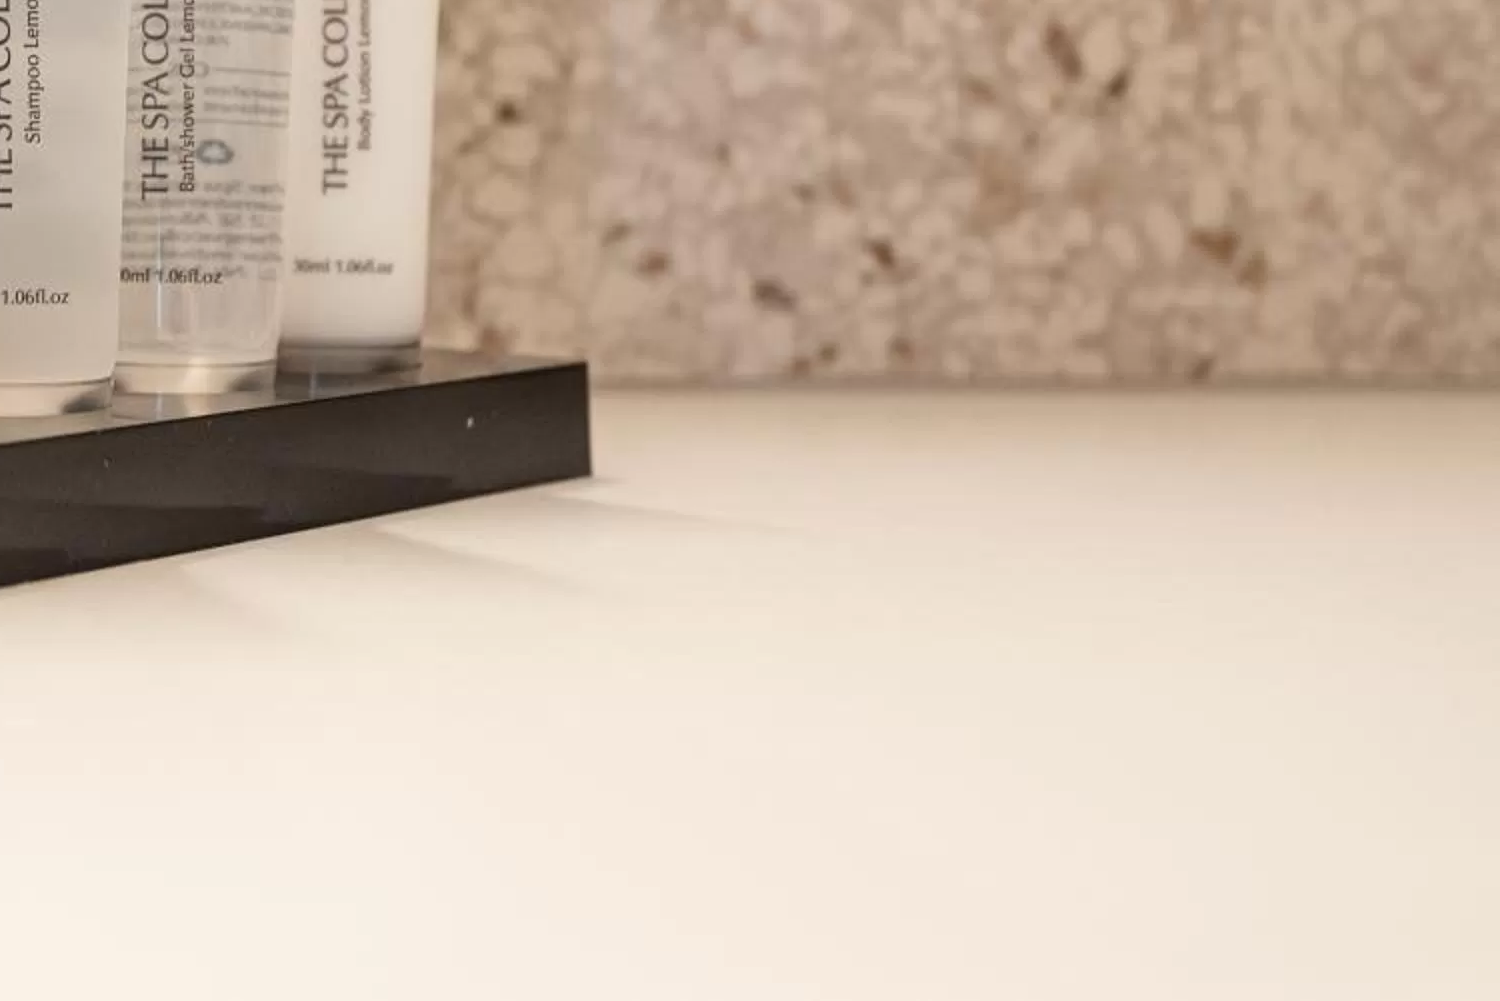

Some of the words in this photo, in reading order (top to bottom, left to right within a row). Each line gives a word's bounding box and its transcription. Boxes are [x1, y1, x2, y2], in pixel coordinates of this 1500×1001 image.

[179, 47, 196, 79] Gel
[357, 51, 372, 104] Lotion
[23, 53, 44, 145] Shampoo
[141, 71, 170, 131] SPA
[322, 73, 350, 129] SPA
[179, 84, 196, 192] Bath/shower
[321, 135, 349, 196] THE
[141, 137, 169, 201] THE
[0, 288, 70, 306] 1.06fl.oz
[120, 267, 151, 284] 0ml
